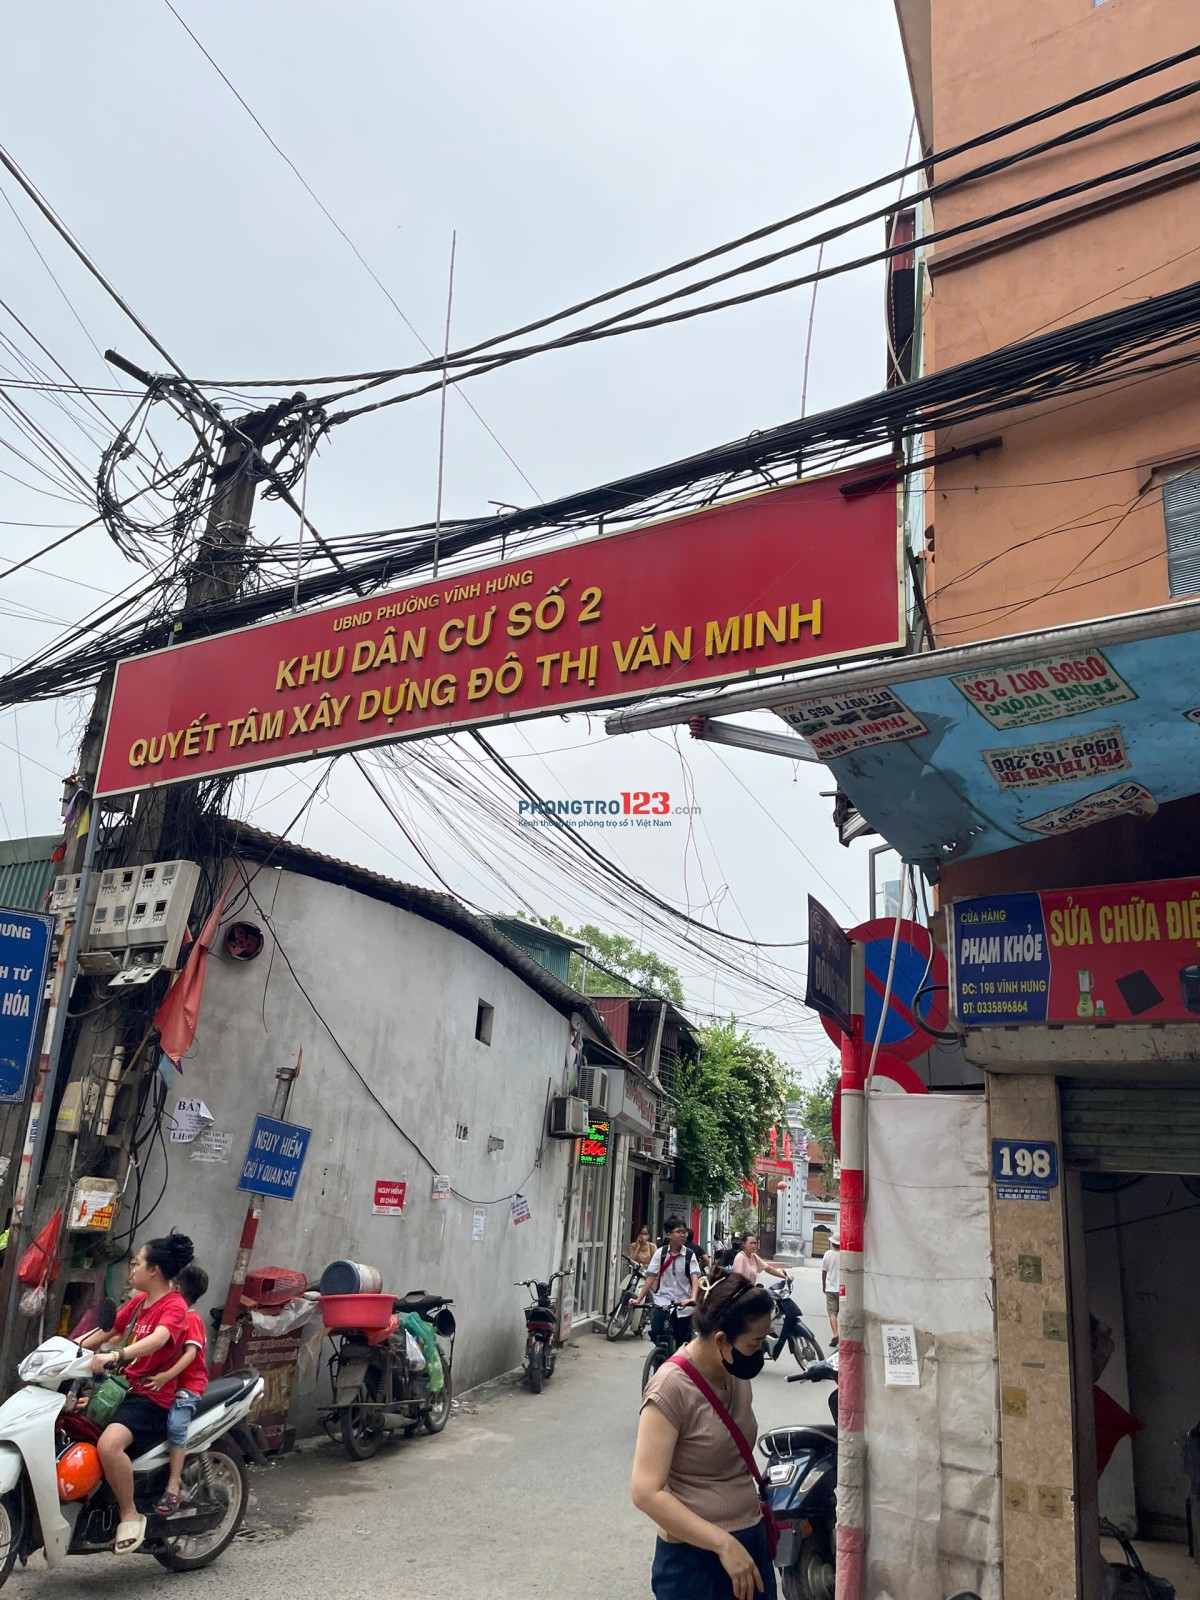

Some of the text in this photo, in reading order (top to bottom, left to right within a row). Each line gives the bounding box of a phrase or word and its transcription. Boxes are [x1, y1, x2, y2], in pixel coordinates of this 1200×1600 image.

[333, 570, 534, 632] UBND PHƯỜNG VĨNH HƯNG
[275, 578, 602, 691] KHU DÂN CƯ SỐ 2
[128, 598, 822, 767] QUYẾT TÂM XÂY DỰNG ĐÔ THỊ VĂN MINH
[1006, 670, 1050, 694] 007
[1047, 655, 1108, 685] 0989
[835, 697, 869, 711] 0971
[963, 678, 1007, 703] 235
[784, 712, 809, 725] 791
[809, 705, 834, 719] 055
[961, 908, 1007, 923] CỬA HÀNG
[1050, 895, 1094, 947] SỬA
[1099, 895, 1161, 944] CHỮA
[961, 924, 1043, 973] PHẠM KHỎE
[13, 965, 33, 982] TỪ
[962, 983, 978, 995] ĐC:
[979, 982, 995, 994] 198
[997, 978, 1018, 994] VĨNH
[2, 989, 30, 1017] HÓA
[962, 1000, 1028, 1014] ĐT: 0335896864
[255, 1129, 304, 1160] NGUY HIỂM
[243, 1158, 297, 1187] CHÚ Ý QUAN SÁT
[999, 1147, 1051, 1178] 198
